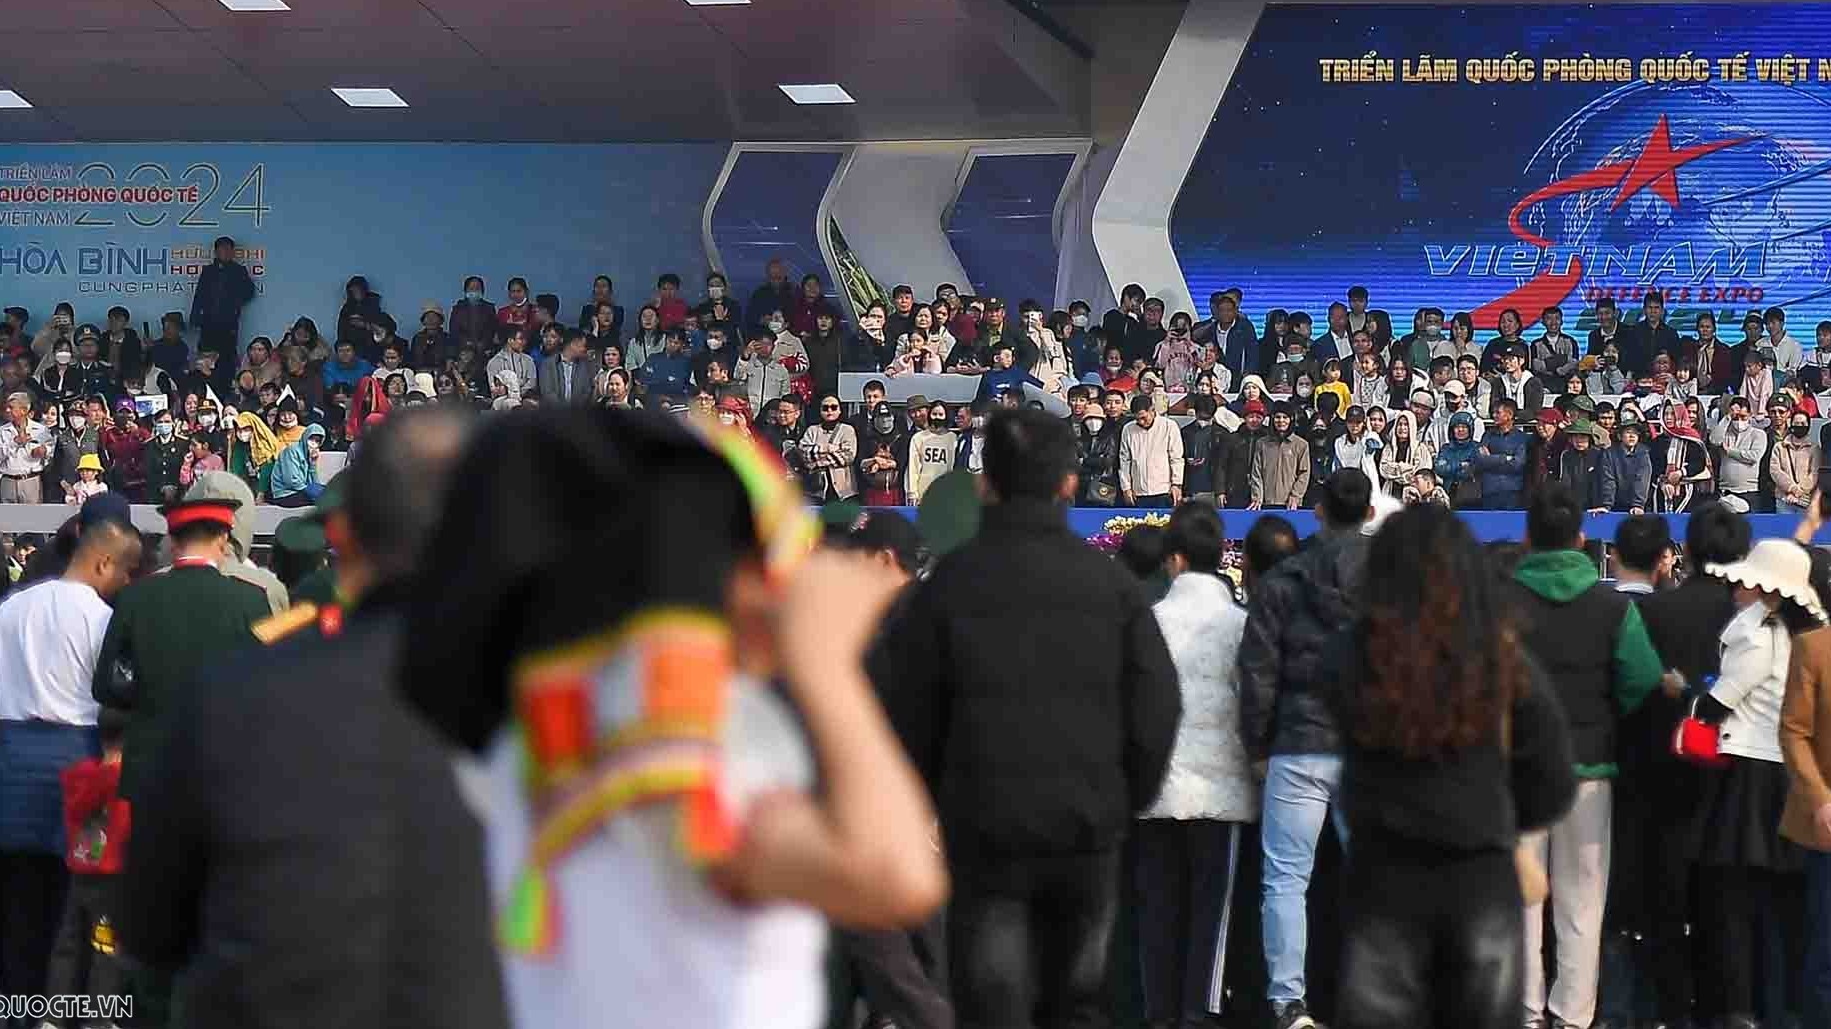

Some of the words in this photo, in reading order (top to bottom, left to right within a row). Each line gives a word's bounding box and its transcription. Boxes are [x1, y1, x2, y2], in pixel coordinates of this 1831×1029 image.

[1319, 50, 1395, 83] TRIỂN
[1402, 54, 1458, 83] LÃM
[1465, 50, 1536, 84] QUỐC
[1543, 52, 1633, 83] PHÒNG
[1640, 50, 1710, 85] QUỐC
[1717, 50, 1751, 82] TẾ
[1755, 53, 1811, 86] VIỆT
[34, 211, 71, 226] NAM
[1584, 286, 1691, 304] DEFECE
[924, 446, 948, 465] SEA
